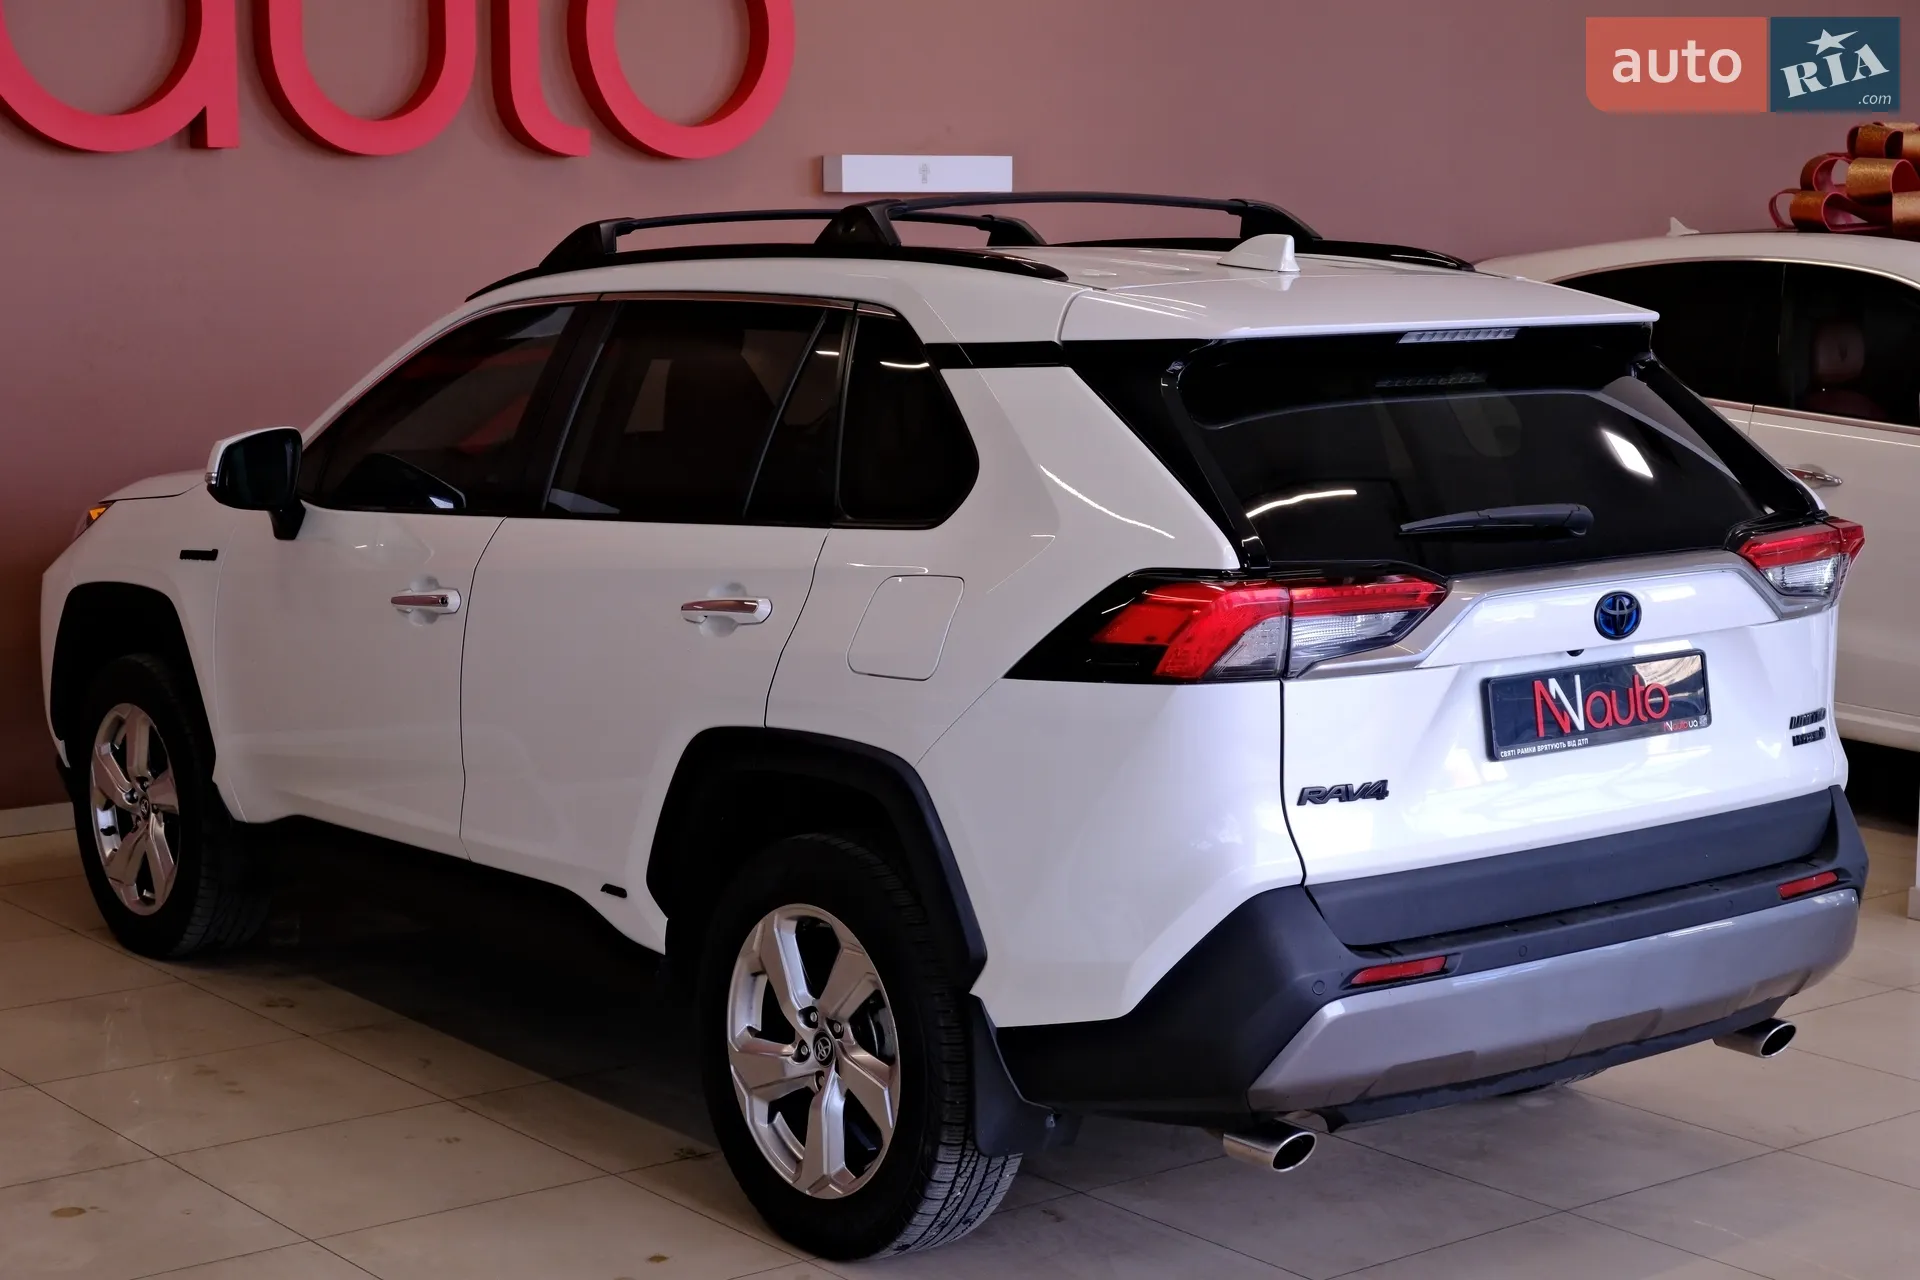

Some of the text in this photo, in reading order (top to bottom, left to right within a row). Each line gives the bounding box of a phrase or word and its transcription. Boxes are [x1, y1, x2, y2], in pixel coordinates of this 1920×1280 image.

[1517, 747, 1536, 755] РАМКИ
[1567, 740, 1577, 748] ВІД
[1577, 738, 1589, 746] ДТП
[1297, 779, 1389, 806] RAV4
